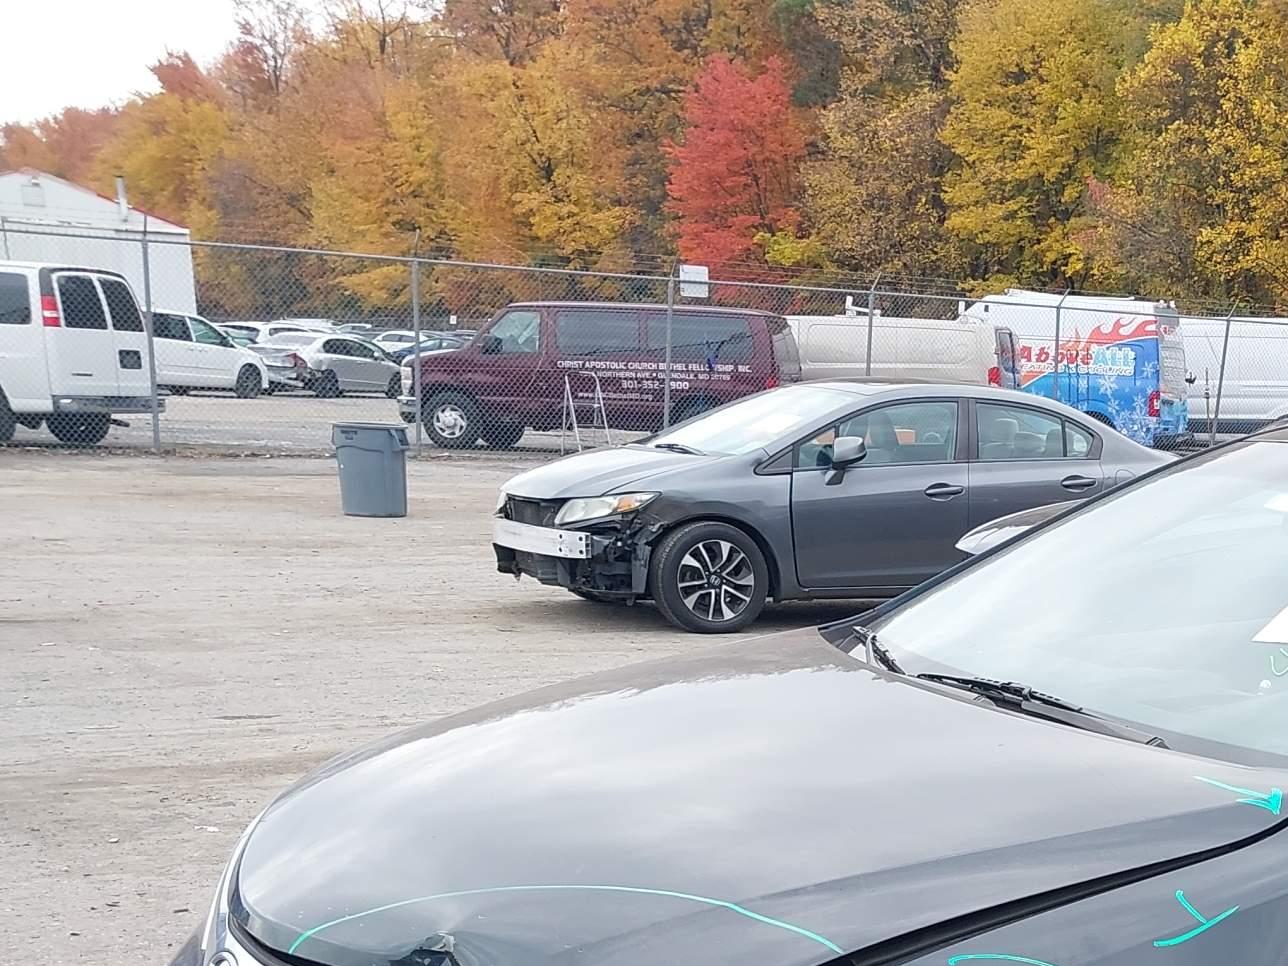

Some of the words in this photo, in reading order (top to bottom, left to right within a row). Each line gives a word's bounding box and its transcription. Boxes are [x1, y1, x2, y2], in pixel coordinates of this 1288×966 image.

[557, 360, 584, 369] CHRIST
[585, 361, 627, 370] APOSTOLIC
[628, 362, 657, 370] CHURCH
[597, 371, 636, 379] NORTHERN
[657, 372, 697, 380] GLNDALE,
[621, 380, 690, 390] 301-352-900
